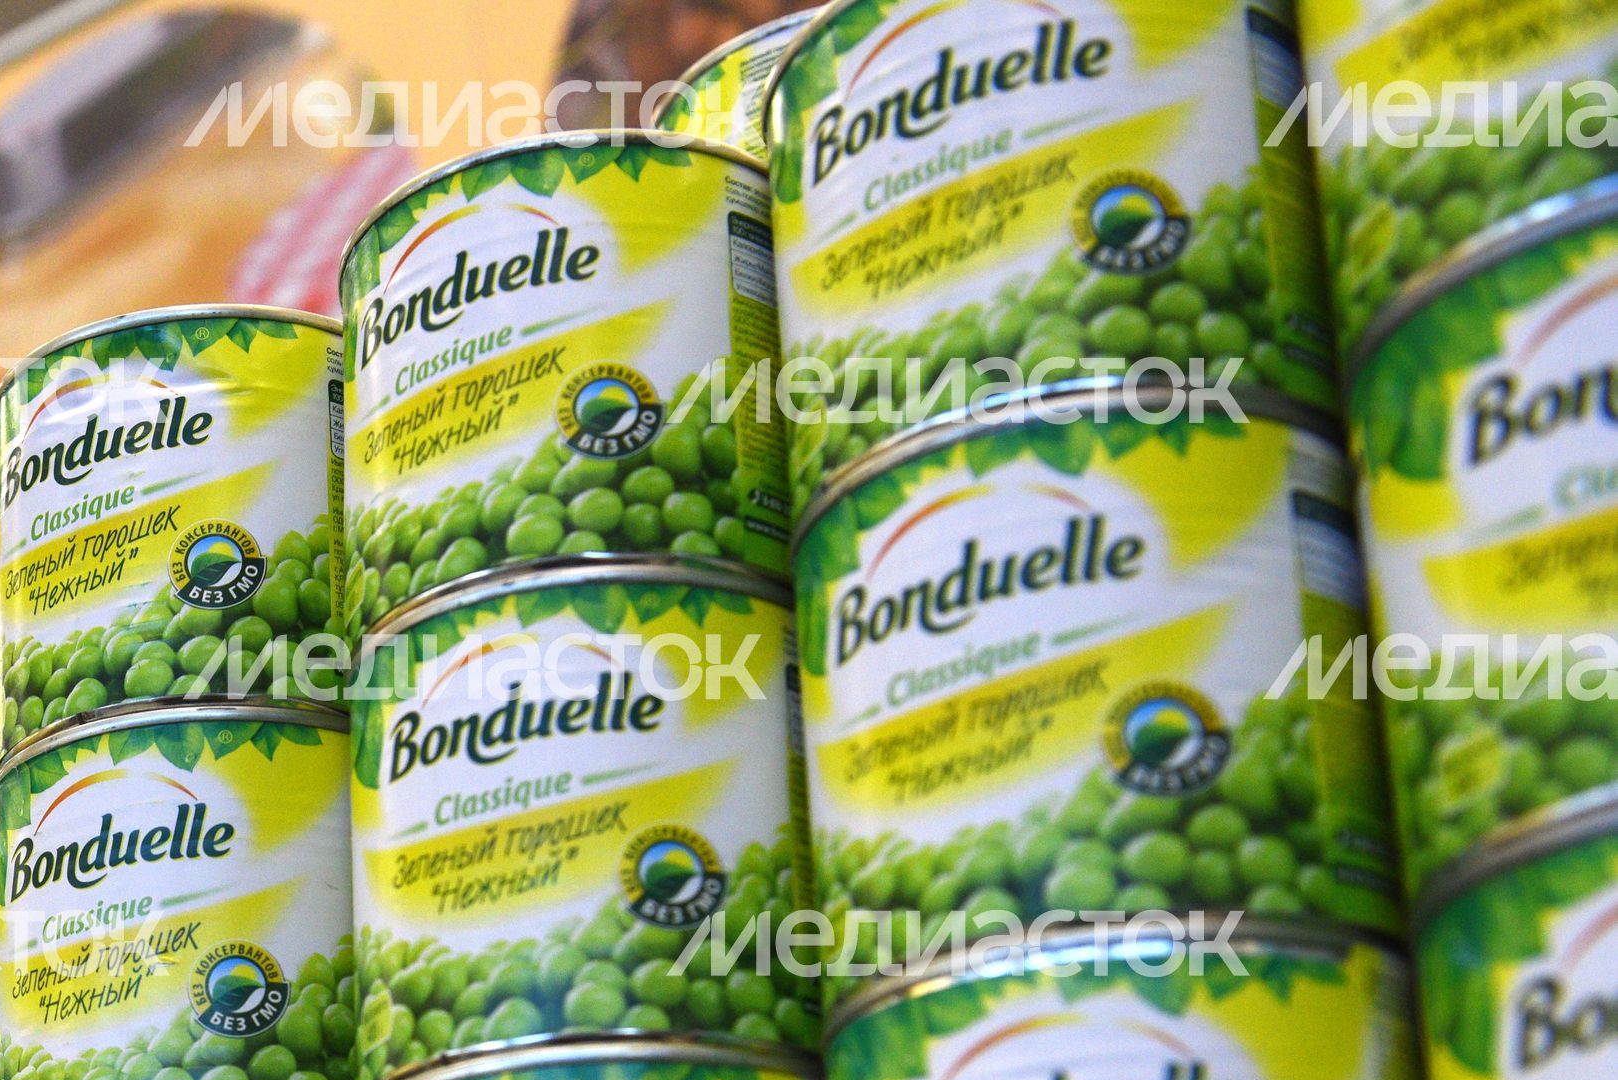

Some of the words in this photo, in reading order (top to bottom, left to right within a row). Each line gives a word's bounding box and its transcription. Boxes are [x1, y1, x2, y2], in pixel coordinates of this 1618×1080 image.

[813, 18, 1114, 187] Bonduelle
[863, 127, 1015, 211] Classique
[360, 226, 600, 372] Bonduelle
[394, 324, 514, 396] Classique
[3, 395, 213, 517] Bonduelle
[576, 434, 619, 455] БЕЗ
[622, 410, 658, 450] ГМО
[1466, 365, 1618, 472] Bon
[5, 539, 76, 600] Зеленый
[81, 504, 181, 562] горошек
[30, 485, 135, 541] Classique
[174, 521, 257, 557] КОНСЕРВАНТОВ
[188, 586, 224, 604] БЕЗ
[230, 563, 258, 600] ГМО
[835, 512, 1146, 667] Bonduelle
[388, 671, 666, 785] Bonduelle
[434, 771, 575, 827] Classique
[9, 802, 236, 904] Bonduelle
[41, 895, 154, 946] Classique
[11, 943, 90, 1000] Зеленый
[95, 921, 203, 978] горошек
[195, 942, 280, 980] КОНСЕРВАНТОВ
[209, 1010, 248, 1032] БЕЗ
[252, 989, 283, 1029] ГМО
